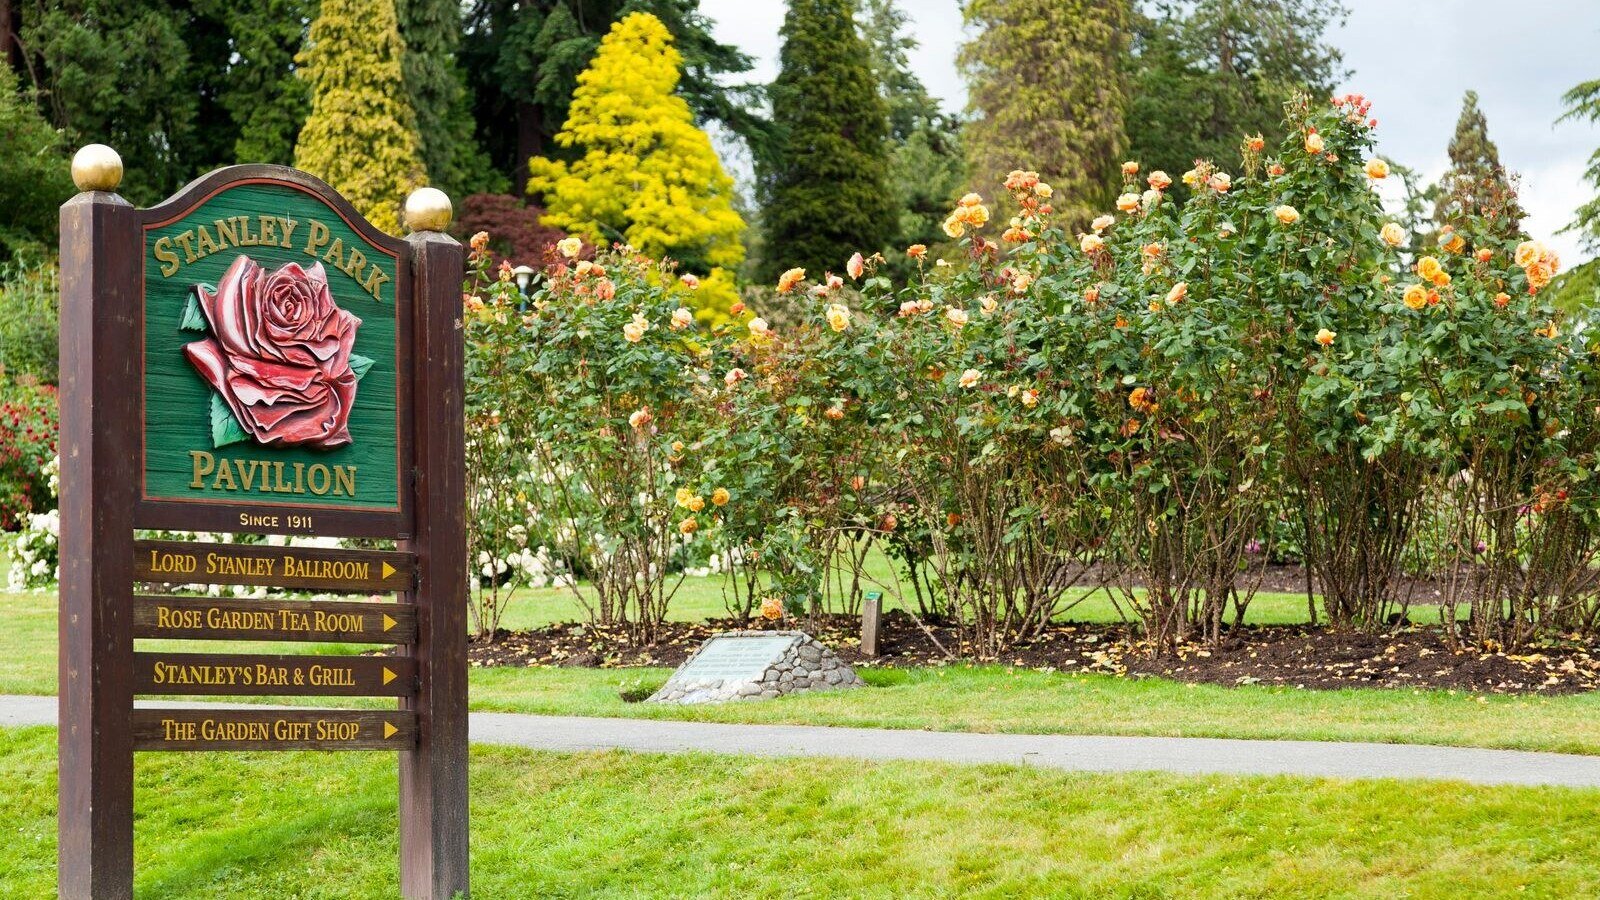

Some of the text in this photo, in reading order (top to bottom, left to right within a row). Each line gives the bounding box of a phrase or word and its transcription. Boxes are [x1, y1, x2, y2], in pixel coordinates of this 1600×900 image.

[154, 215, 390, 302] STANLEY PARK
[189, 450, 357, 496] PAVILION
[239, 512, 313, 529] SINCE 1911
[150, 550, 369, 580] LORD STANLEY BALLROOM
[157, 606, 364, 633] ROSE GARDEN TEA ROOM
[153, 661, 356, 686] STANLEY'S BAR & GRILL
[162, 719, 360, 741] THE GARDEN GIFT SHOP
